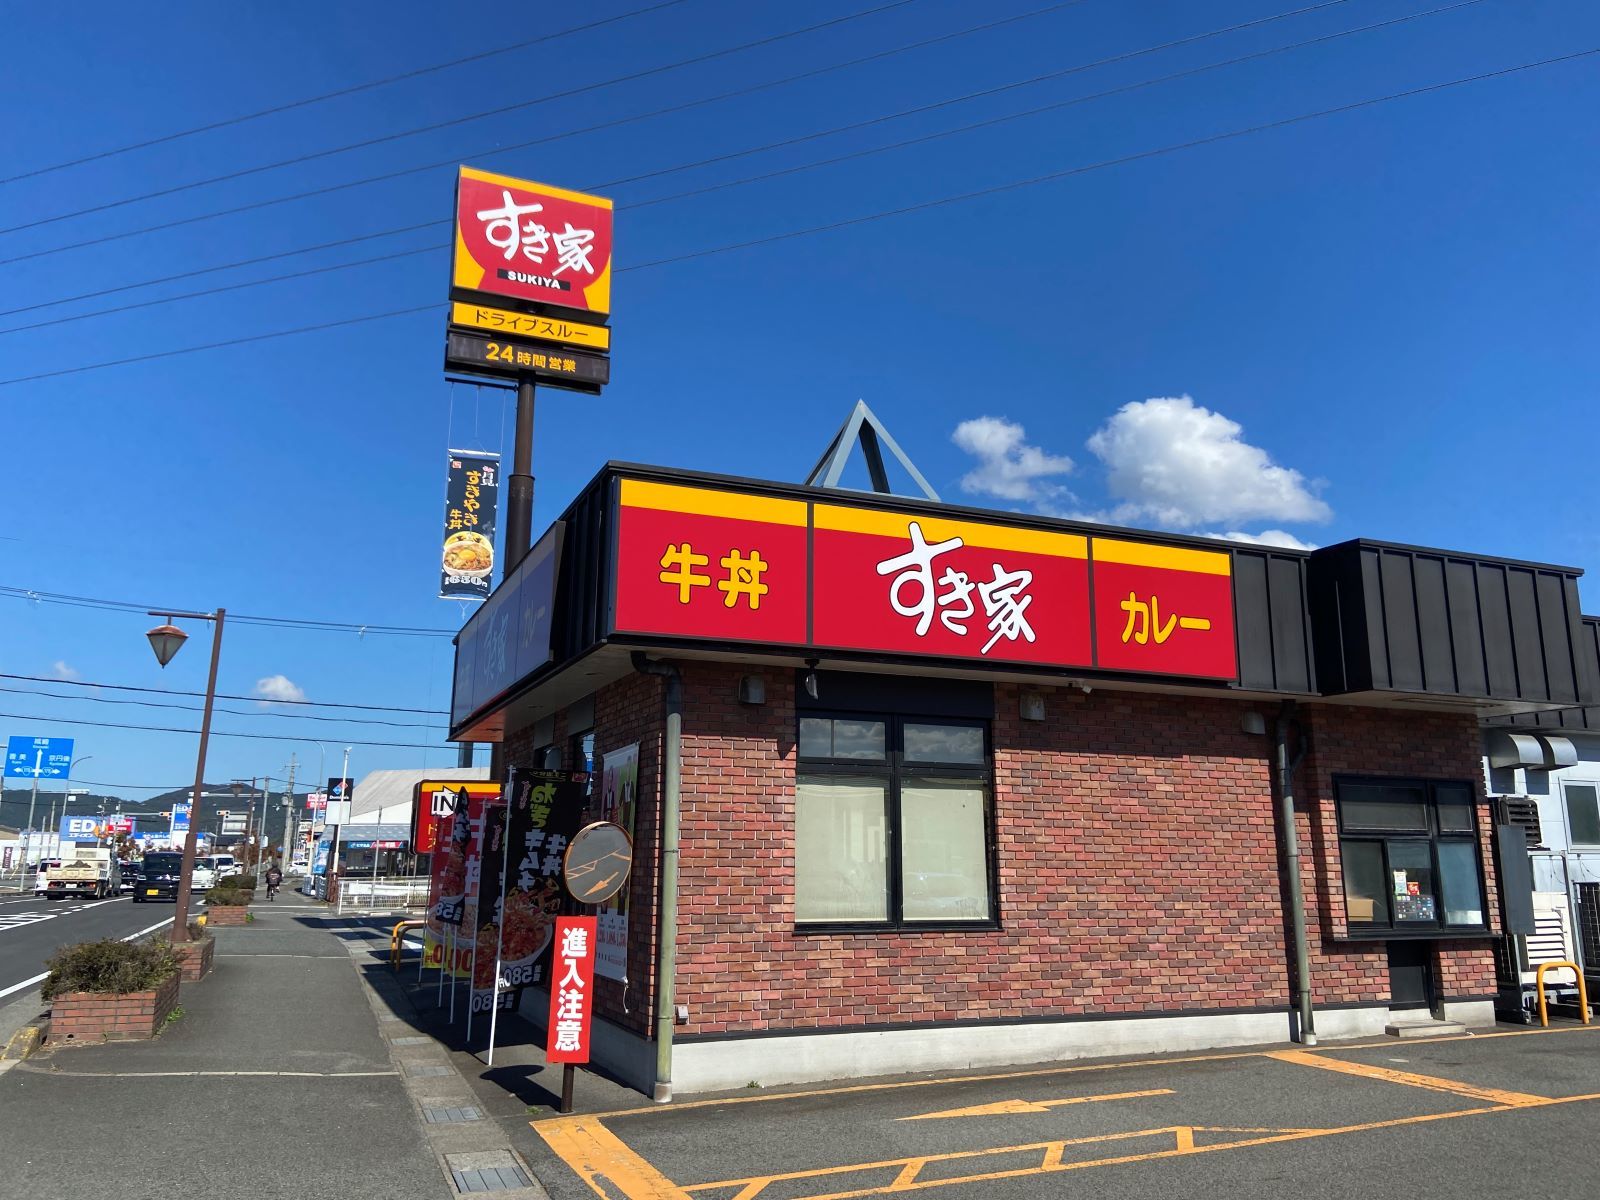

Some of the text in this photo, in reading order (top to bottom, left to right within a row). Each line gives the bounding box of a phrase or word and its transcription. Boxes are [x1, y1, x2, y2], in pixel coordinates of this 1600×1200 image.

[476, 190, 595, 276] すき家
[507, 270, 561, 290] SUKIYA
[475, 309, 589, 338] ドライブスルー
[485, 343, 577, 373] 24時間営業
[659, 542, 770, 611] 牛丼
[876, 521, 1037, 656] すき家
[1120, 591, 1212, 646] カレー
[433, 794, 456, 812] IN
[555, 927, 588, 1051] 進入注意
